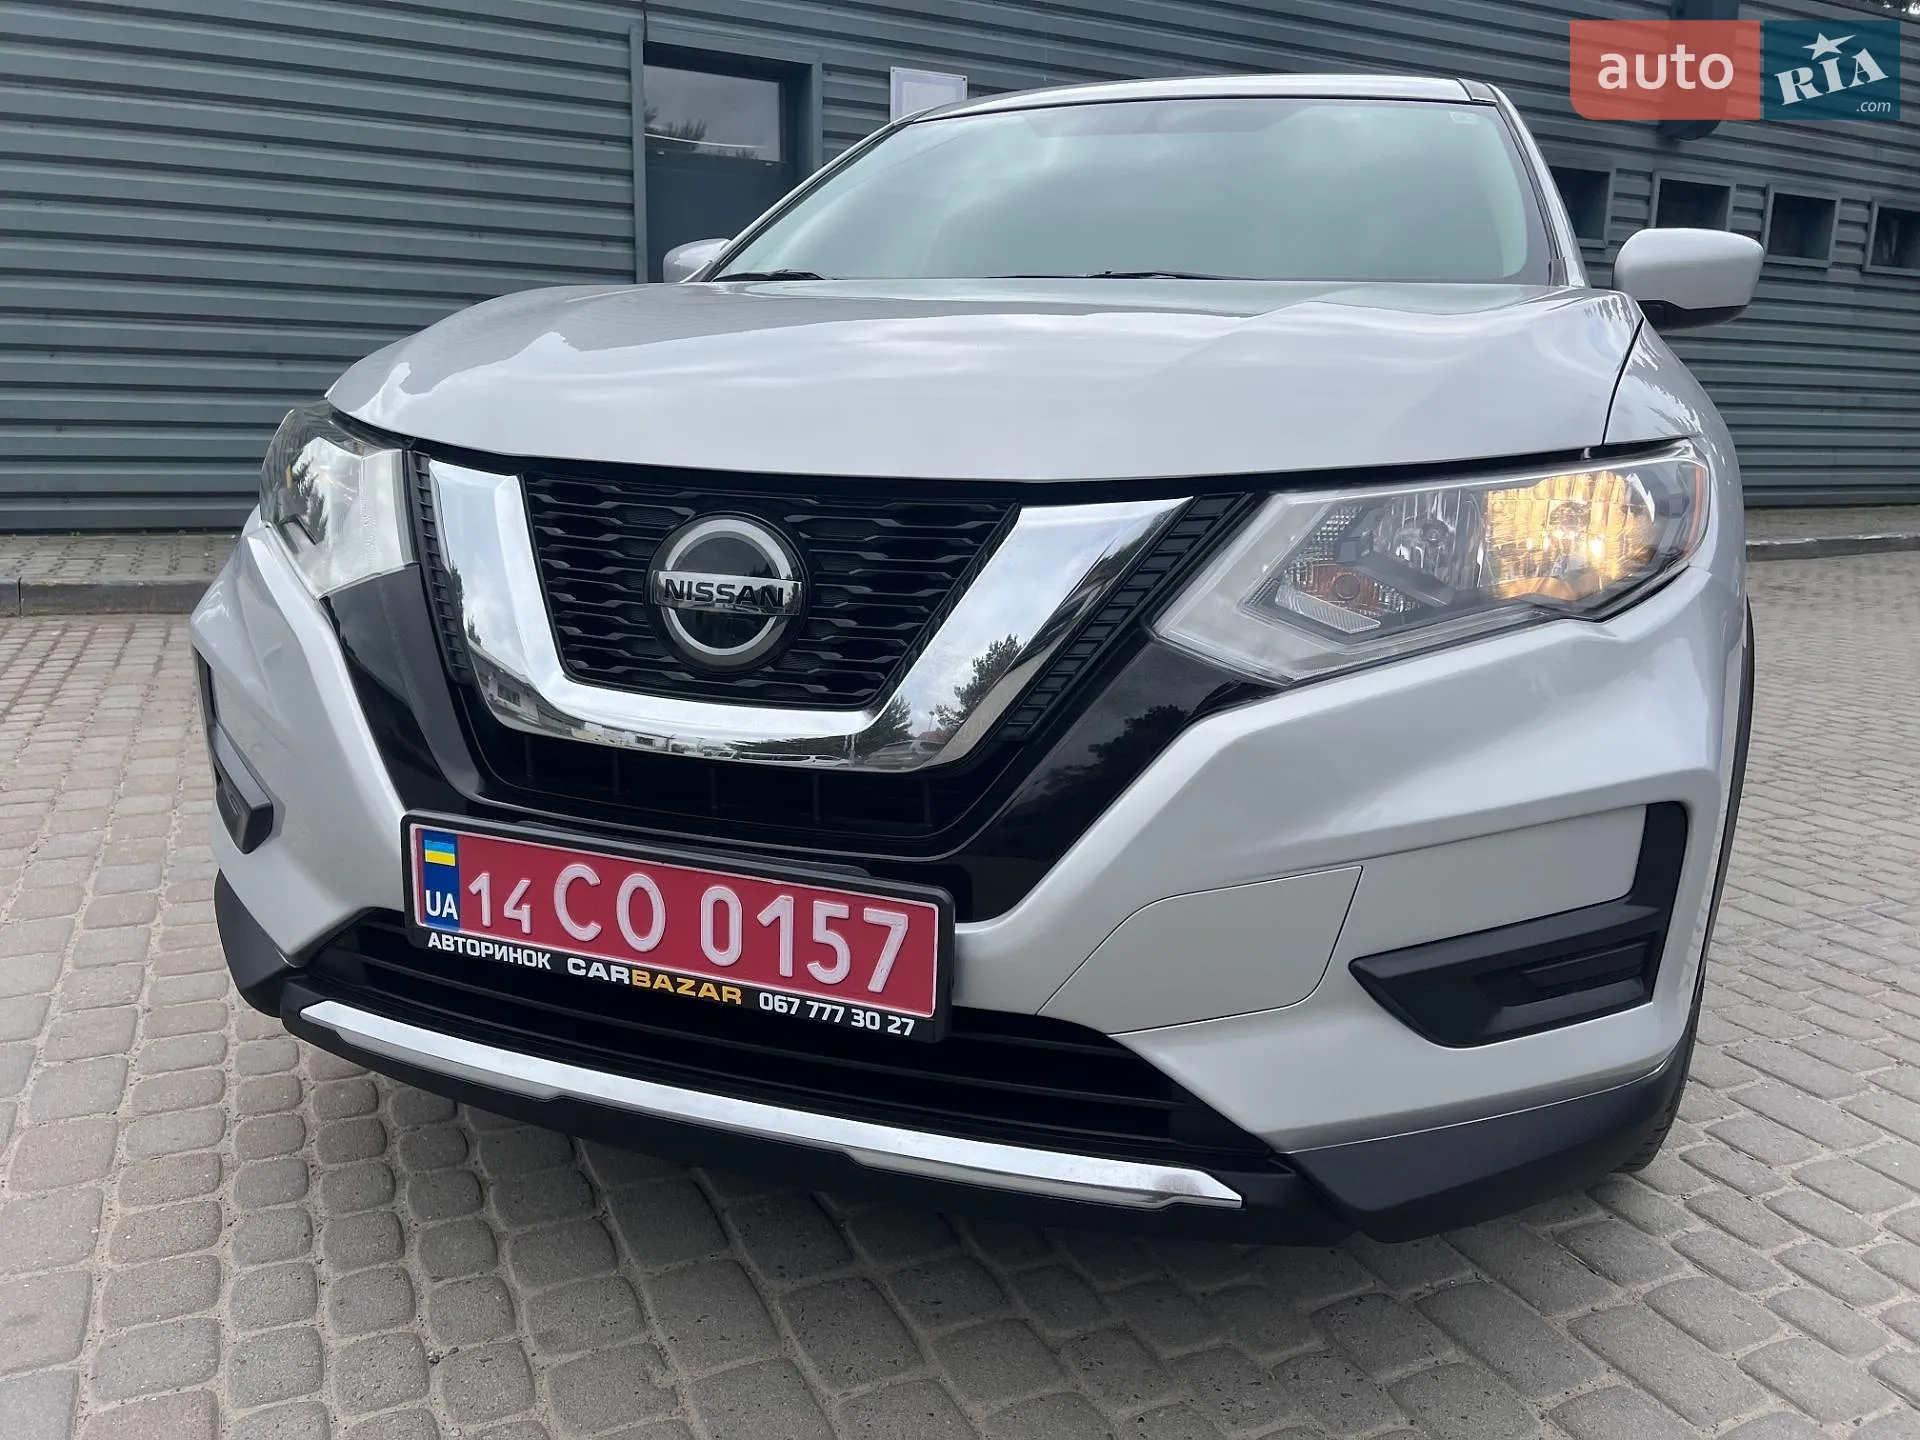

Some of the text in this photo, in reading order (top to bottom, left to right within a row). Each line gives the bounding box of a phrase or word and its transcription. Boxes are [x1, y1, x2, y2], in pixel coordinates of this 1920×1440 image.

[664, 578, 784, 608] NISSAN
[425, 889, 459, 921] UA
[427, 931, 552, 971] АВТОРИНОК
[468, 872, 532, 935] 14
[700, 885, 909, 993] 0157
[566, 957, 743, 1005] CARBAZAR
[758, 991, 915, 1037] 067 777 30 27
